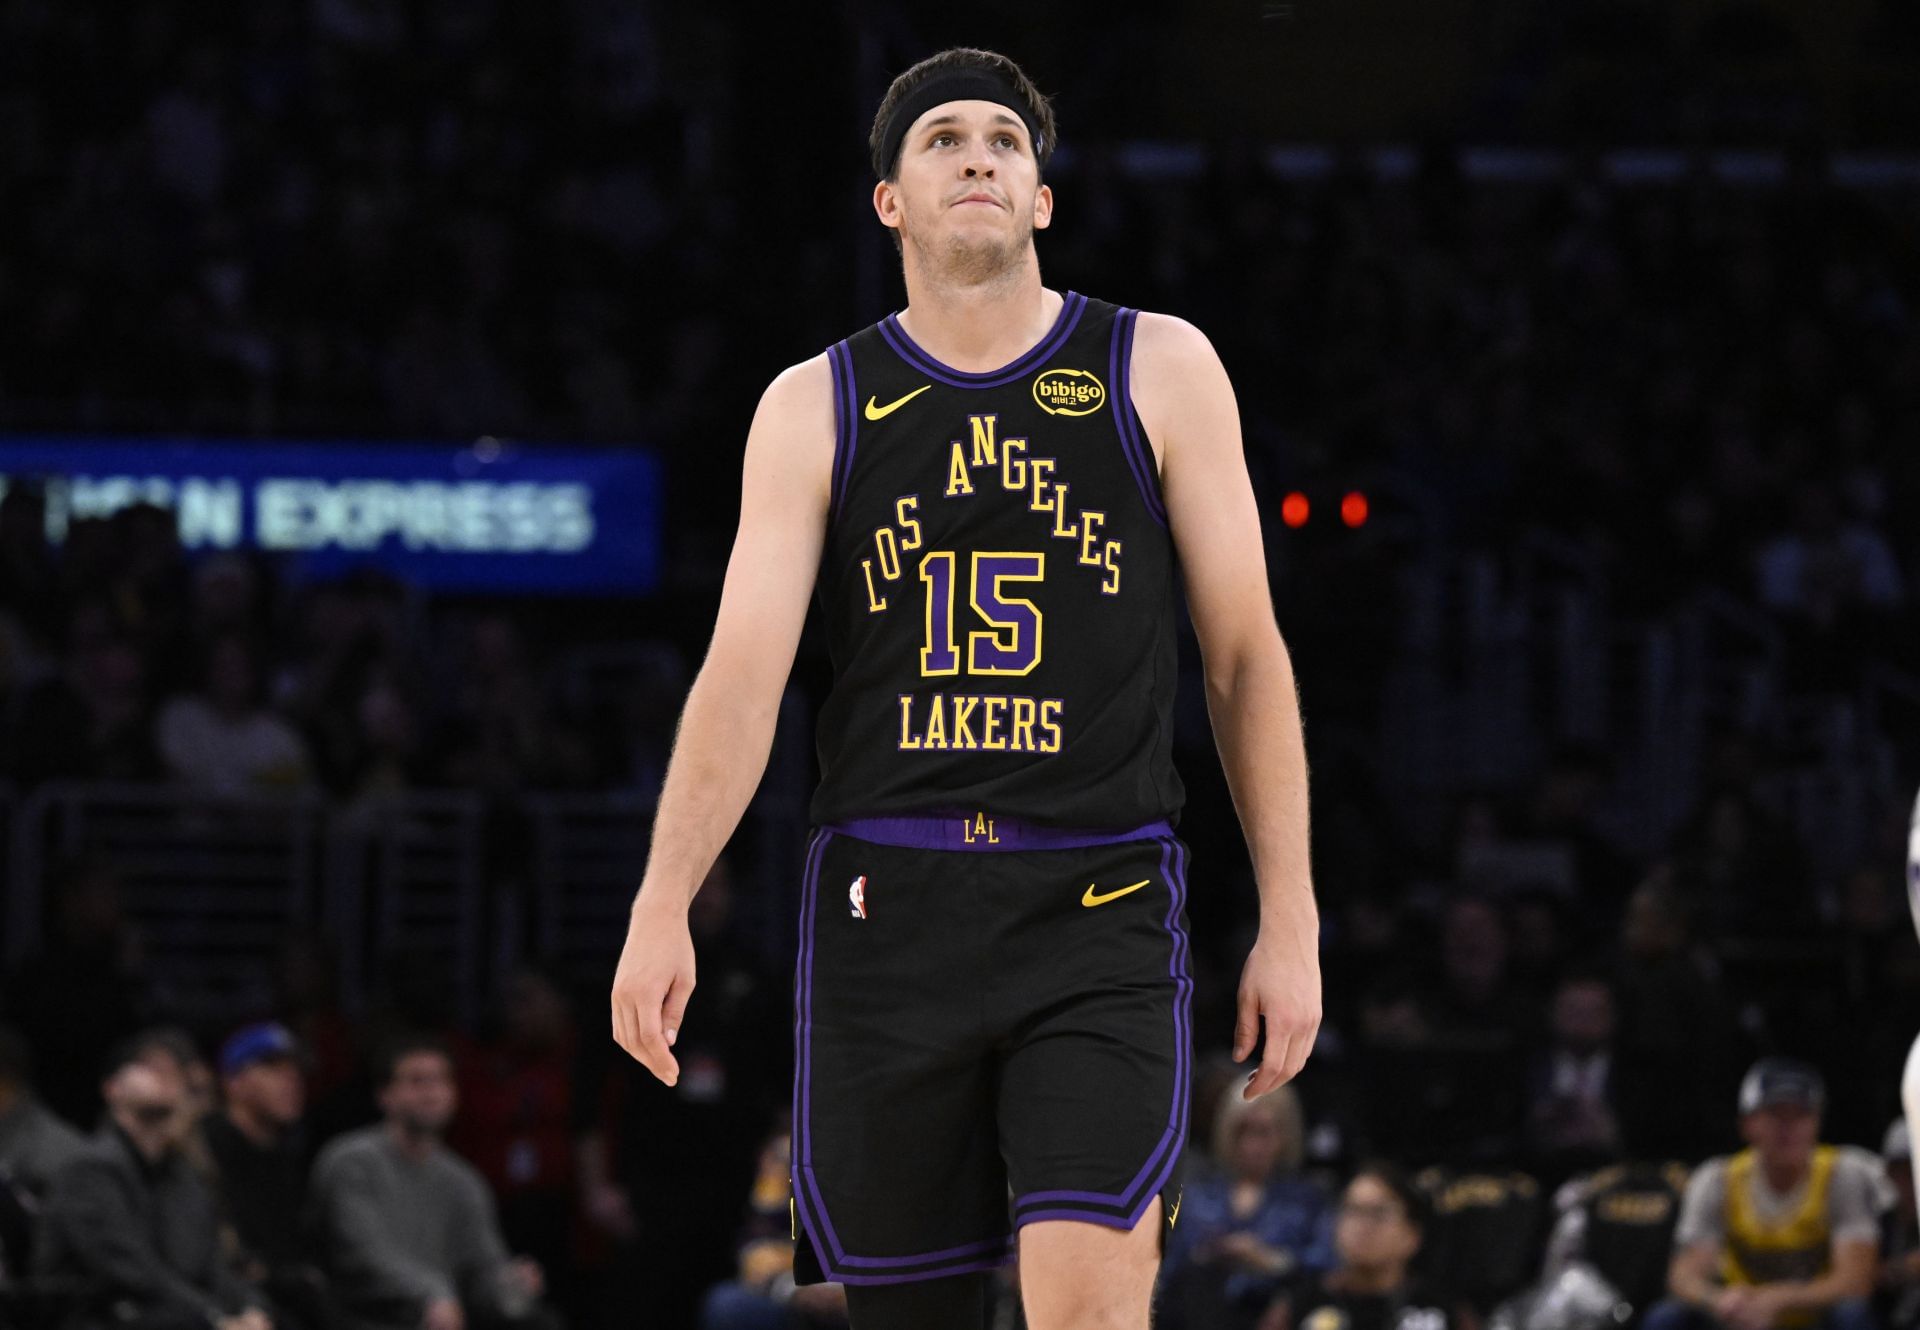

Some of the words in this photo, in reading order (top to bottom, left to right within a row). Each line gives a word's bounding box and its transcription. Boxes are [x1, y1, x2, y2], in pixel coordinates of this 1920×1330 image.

[1040, 381, 1101, 402] bibigo
[861, 494, 923, 612] LOS
[944, 413, 1121, 594] ANGELES
[919, 551, 1045, 677] 15
[898, 693, 1064, 755] LAKERS
[964, 811, 999, 844] LAL
